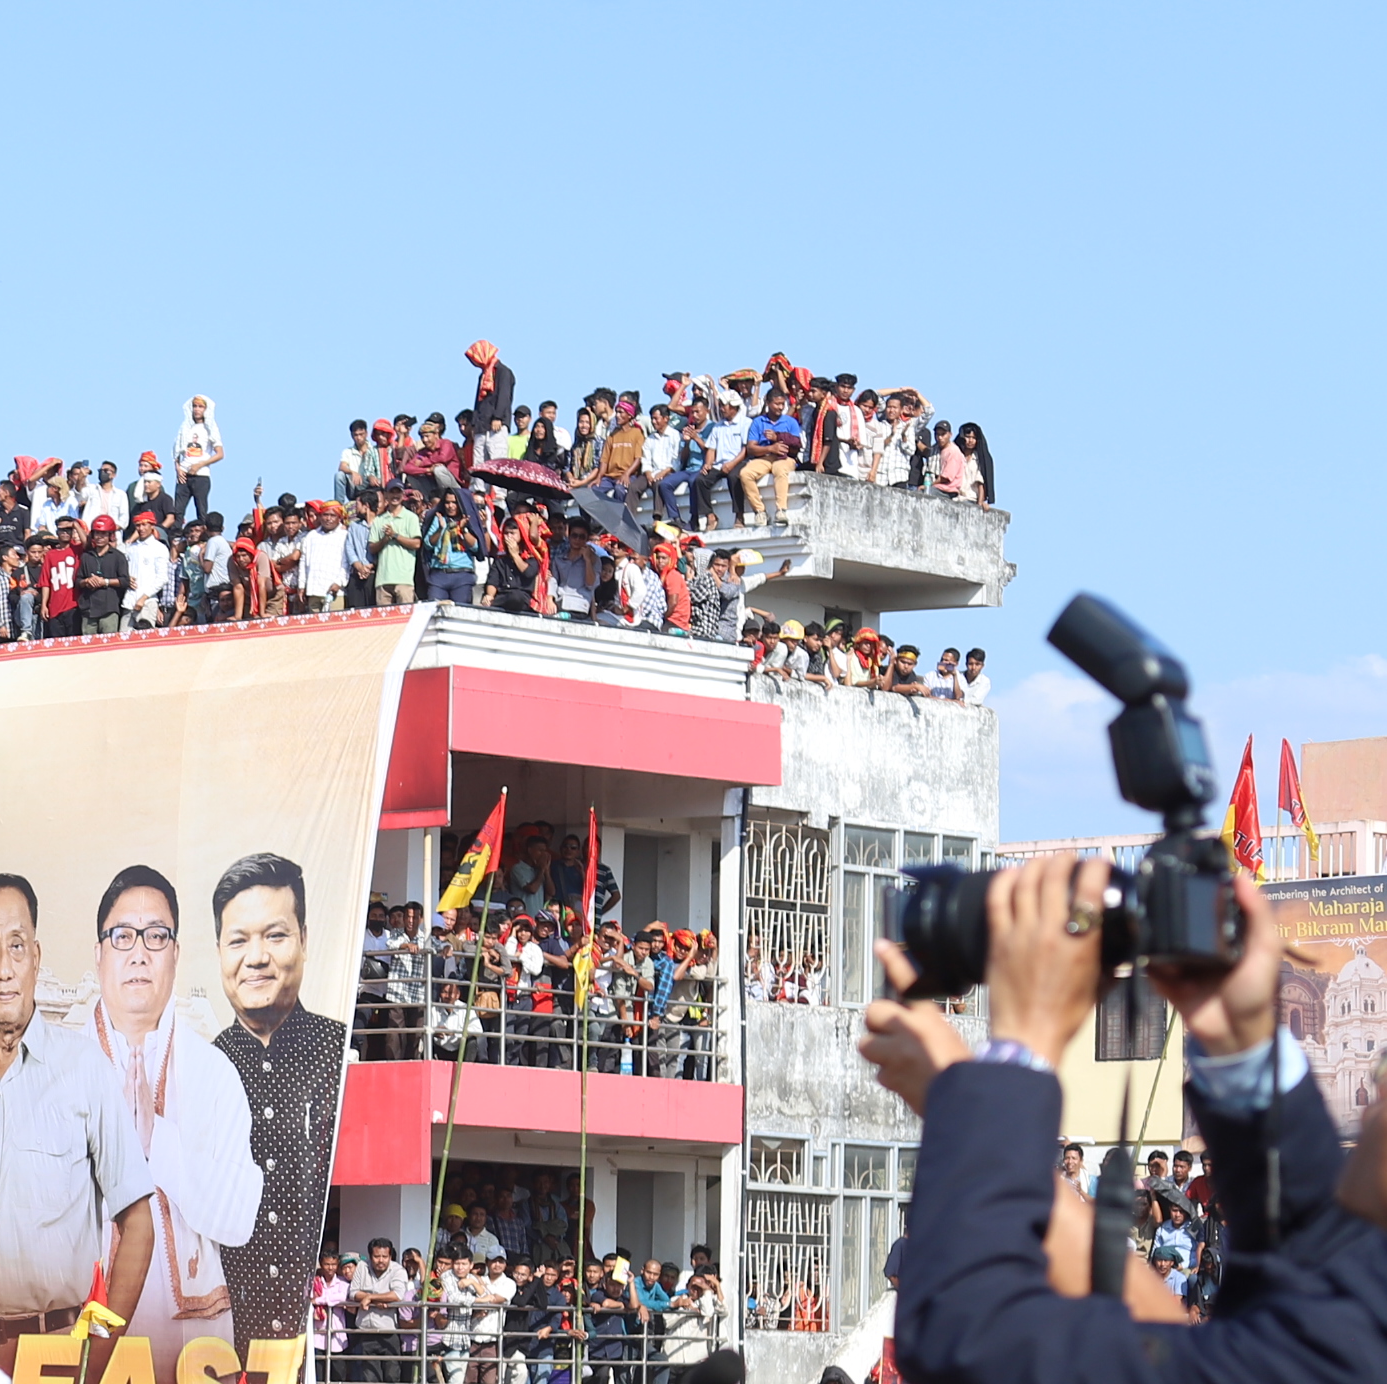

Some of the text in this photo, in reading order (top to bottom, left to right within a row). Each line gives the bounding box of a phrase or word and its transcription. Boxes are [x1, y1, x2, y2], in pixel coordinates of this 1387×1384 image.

[50, 556, 75, 592] Hi
[1312, 888, 1327, 897] the
[1330, 885, 1372, 896] Architect
[1374, 883, 1384, 893] of
[1308, 898, 1384, 917] Maharaja
[1296, 920, 1354, 937] Bikram
